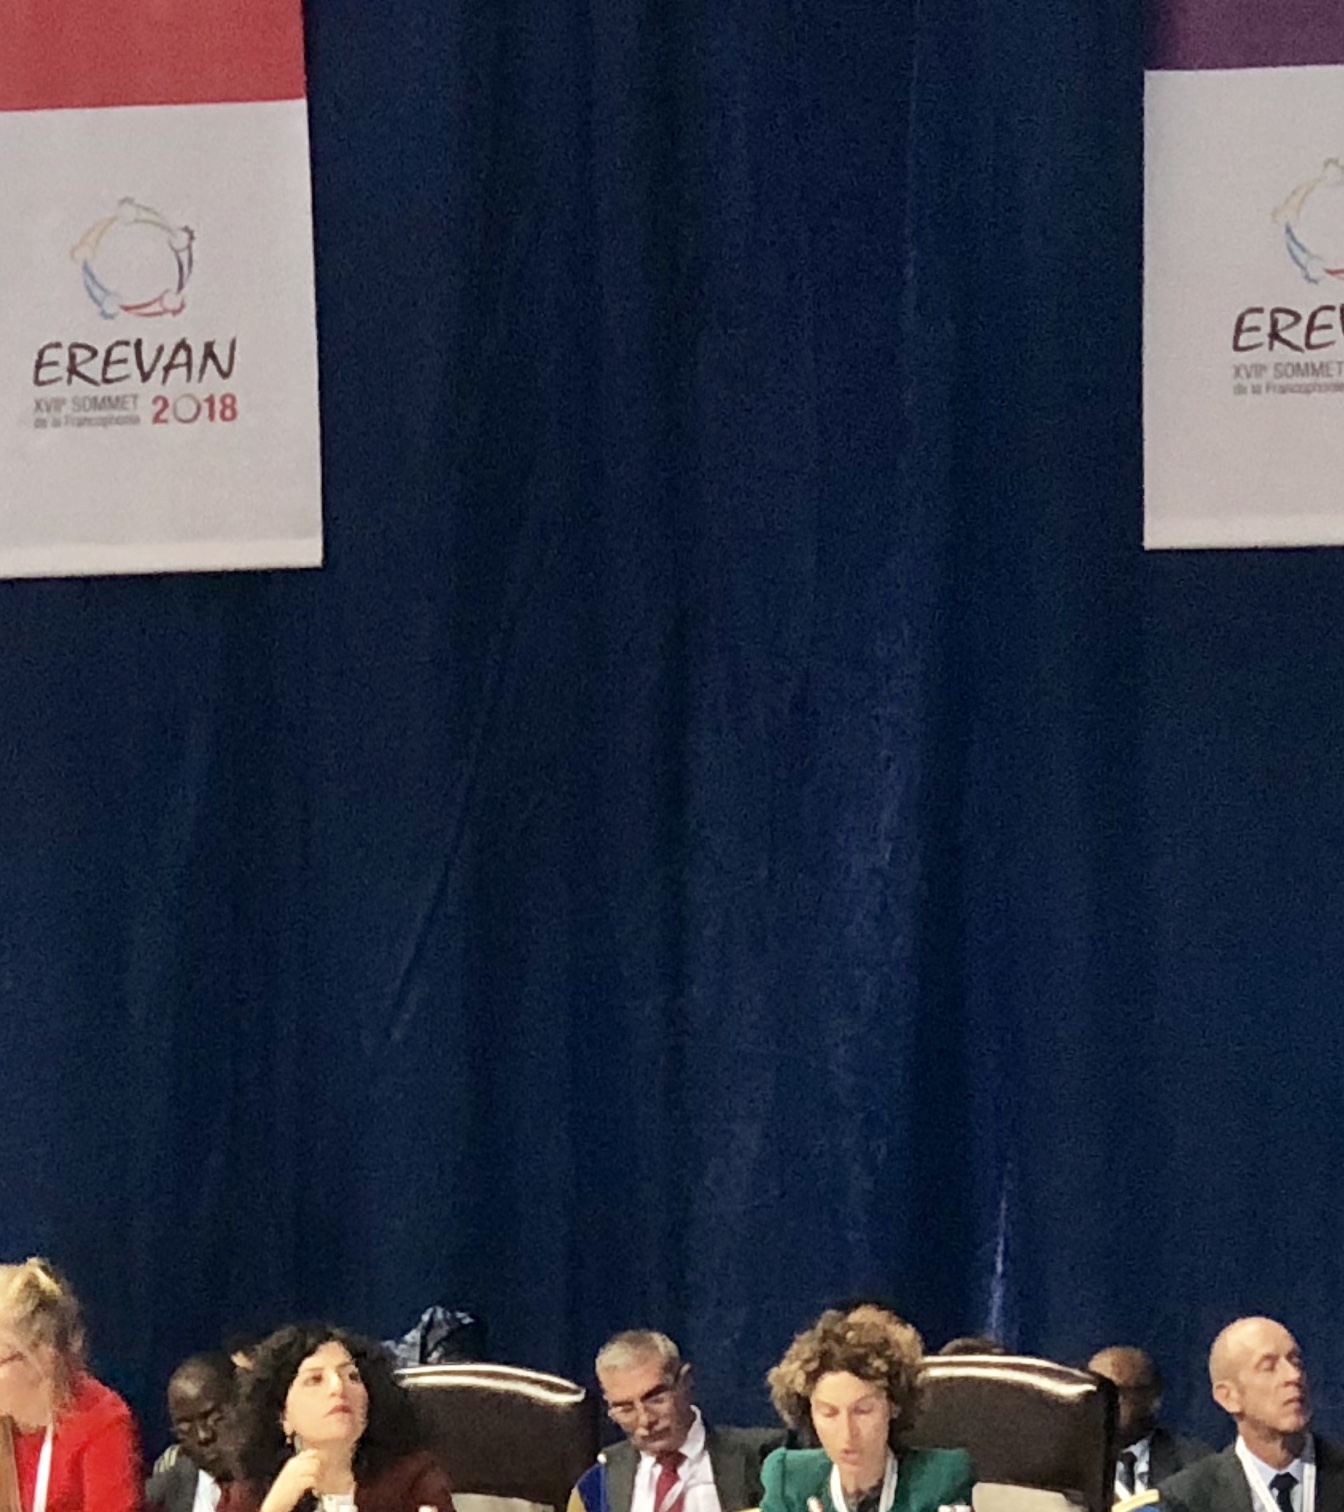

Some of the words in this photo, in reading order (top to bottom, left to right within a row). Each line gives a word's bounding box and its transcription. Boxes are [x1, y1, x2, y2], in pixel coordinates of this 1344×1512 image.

[33, 337, 236, 387] EREVAN
[1273, 360, 1344, 379] SOMMET
[72, 394, 139, 412] SOMMET
[152, 393, 238, 424] 2018
